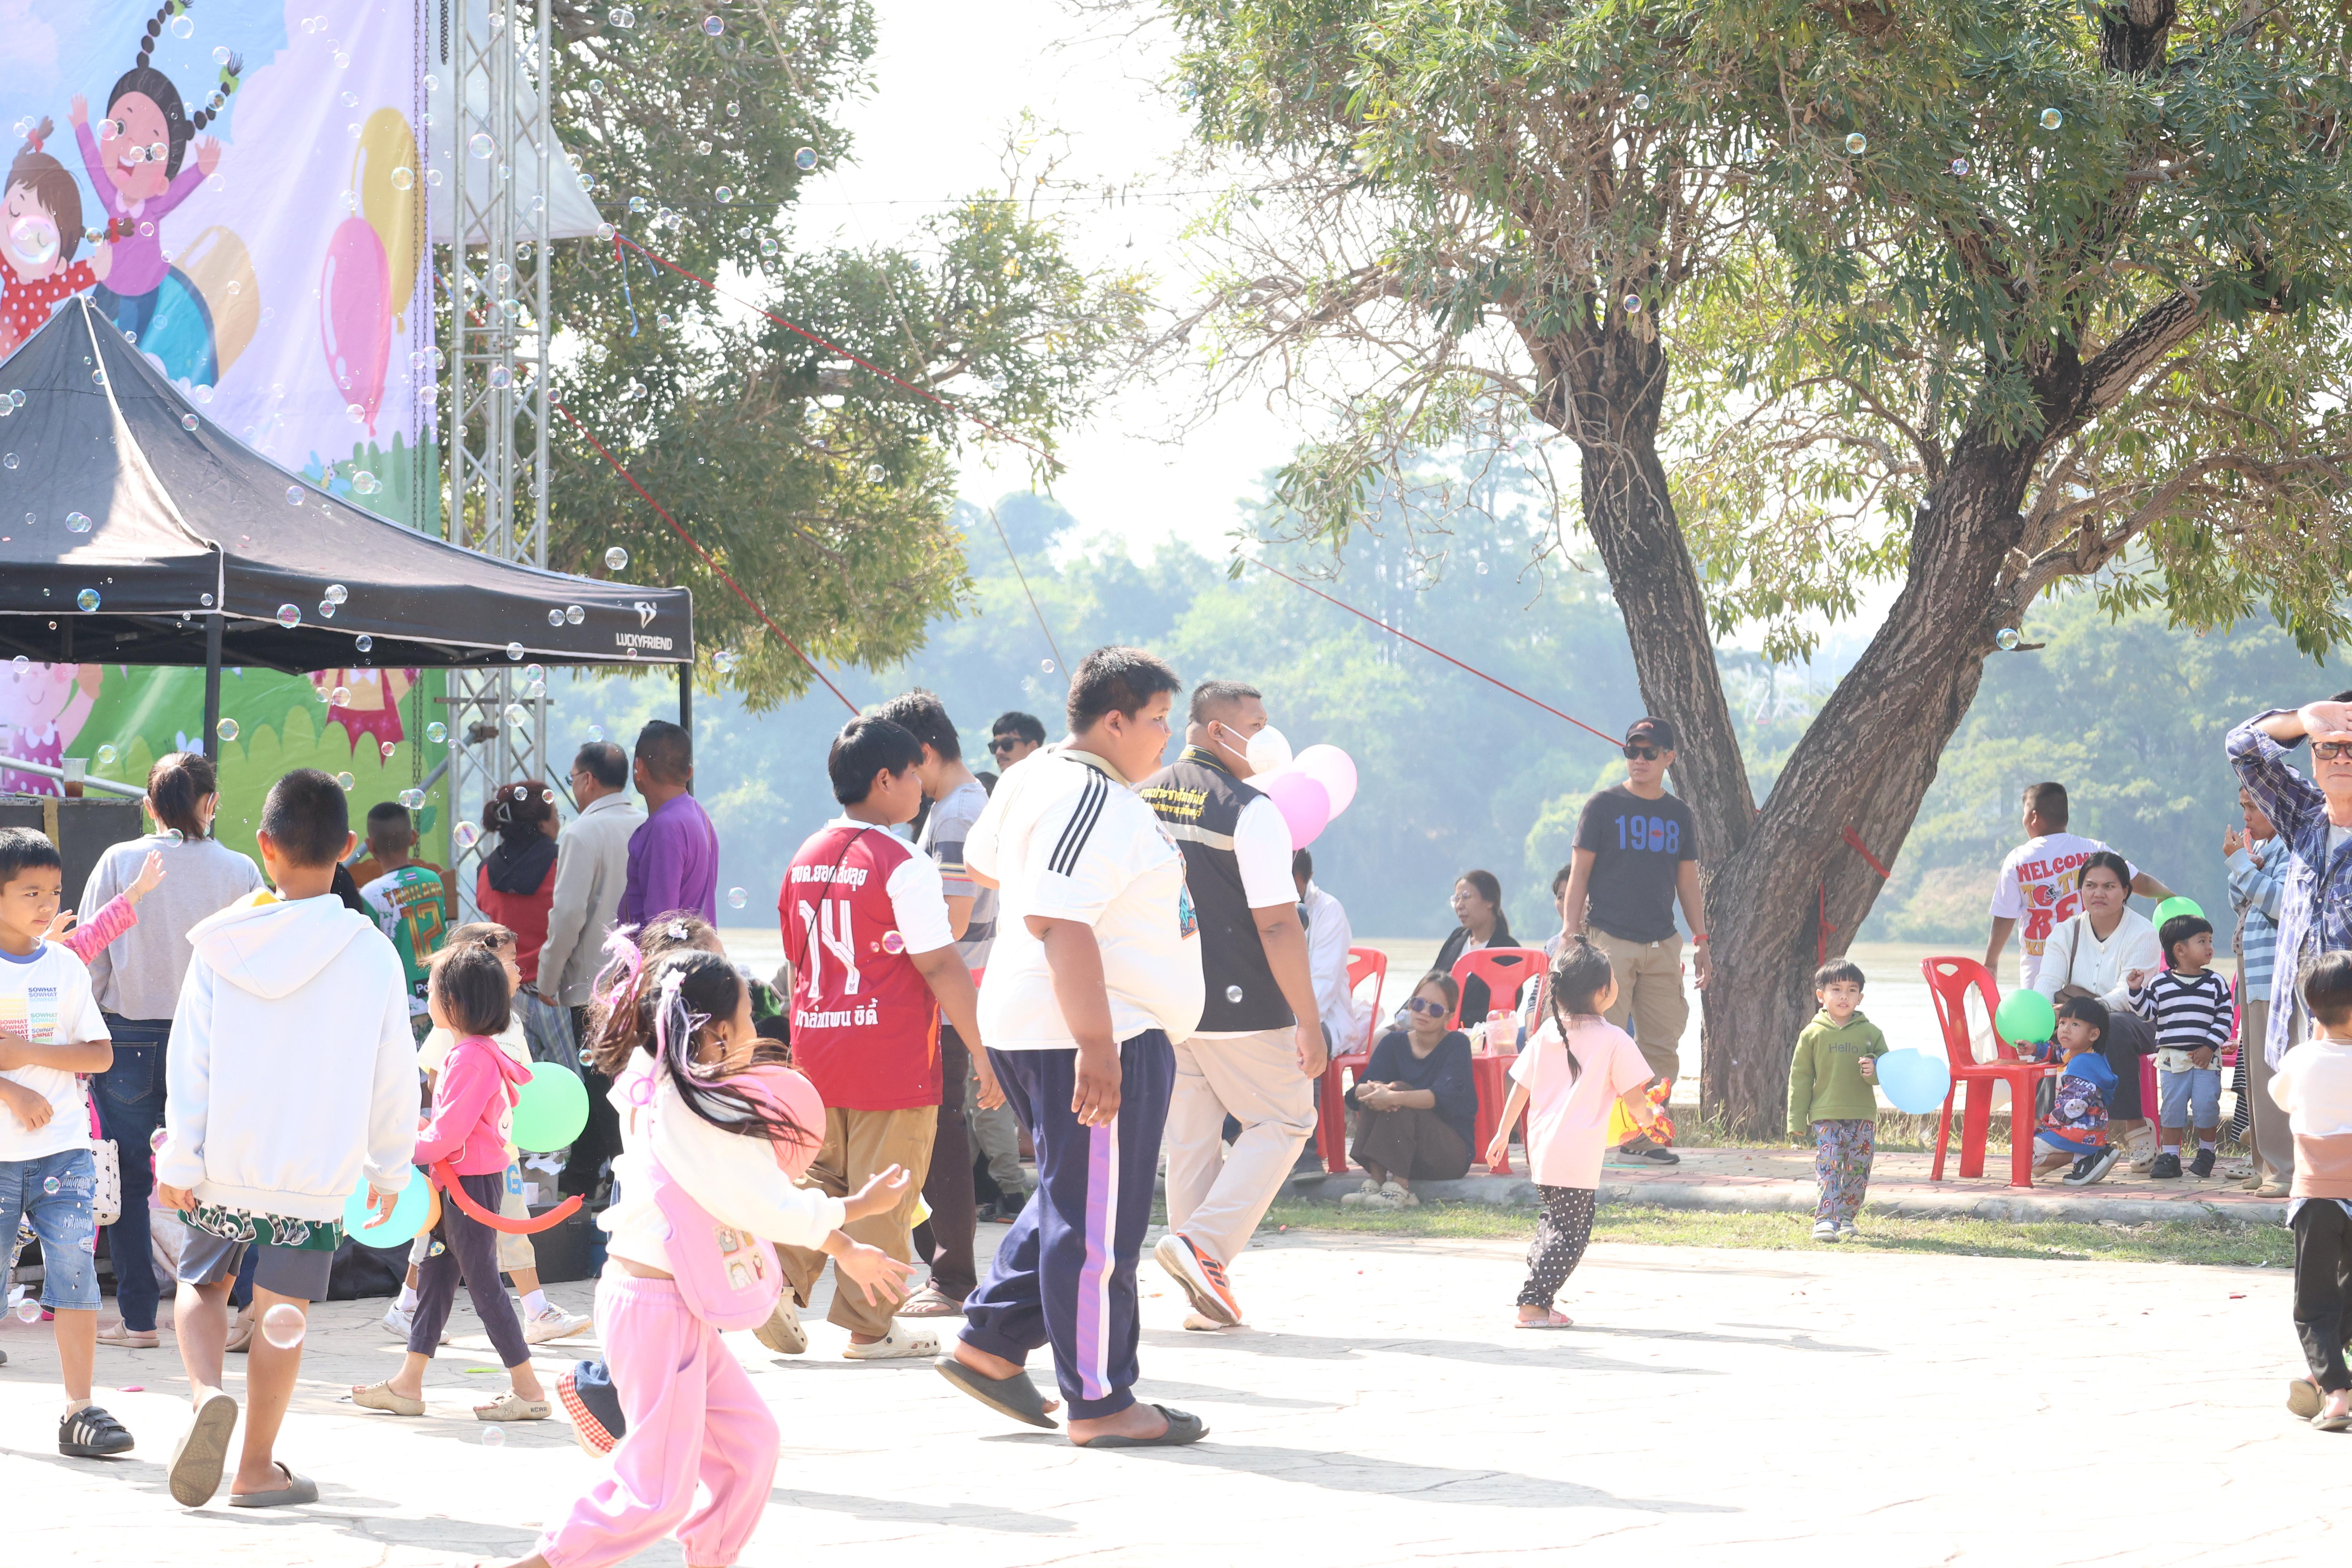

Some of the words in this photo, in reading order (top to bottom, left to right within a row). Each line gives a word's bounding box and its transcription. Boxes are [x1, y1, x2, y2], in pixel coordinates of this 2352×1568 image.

[616, 633, 673, 651] LUCKYFRIEND
[1615, 815, 1679, 854] 1908
[2016, 852, 2093, 882] WELCOM
[2024, 892, 2085, 940] RE
[799, 898, 861, 998] 14
